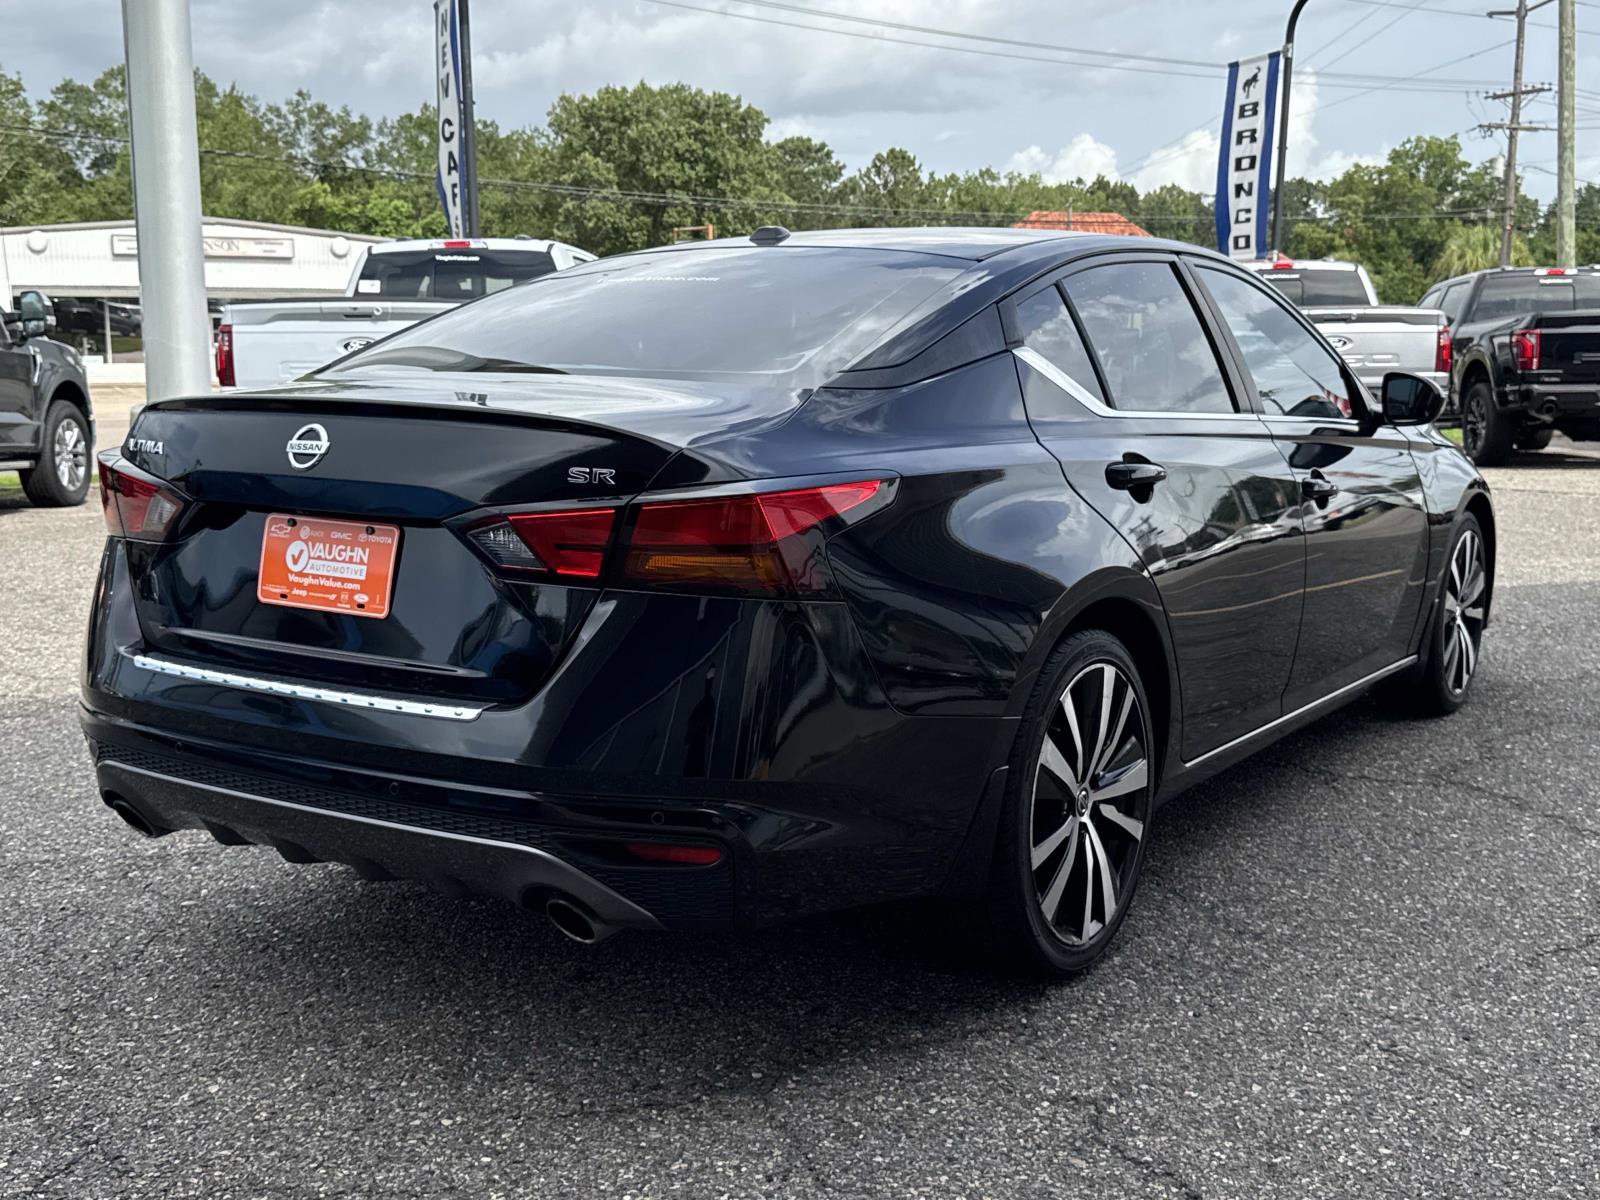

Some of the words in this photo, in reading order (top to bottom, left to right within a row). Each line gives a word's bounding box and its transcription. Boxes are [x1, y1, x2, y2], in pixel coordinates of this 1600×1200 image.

[1233, 101, 1259, 250] BRONCO
[289, 441, 323, 452] NISSAN
[567, 467, 616, 485] SR
[330, 530, 353, 540] GMC
[367, 533, 393, 545] TOYOTA
[308, 541, 369, 564] VAUGHN
[309, 563, 365, 578] AUTOMOTIVE
[288, 573, 361, 591] VaughnValue.com
